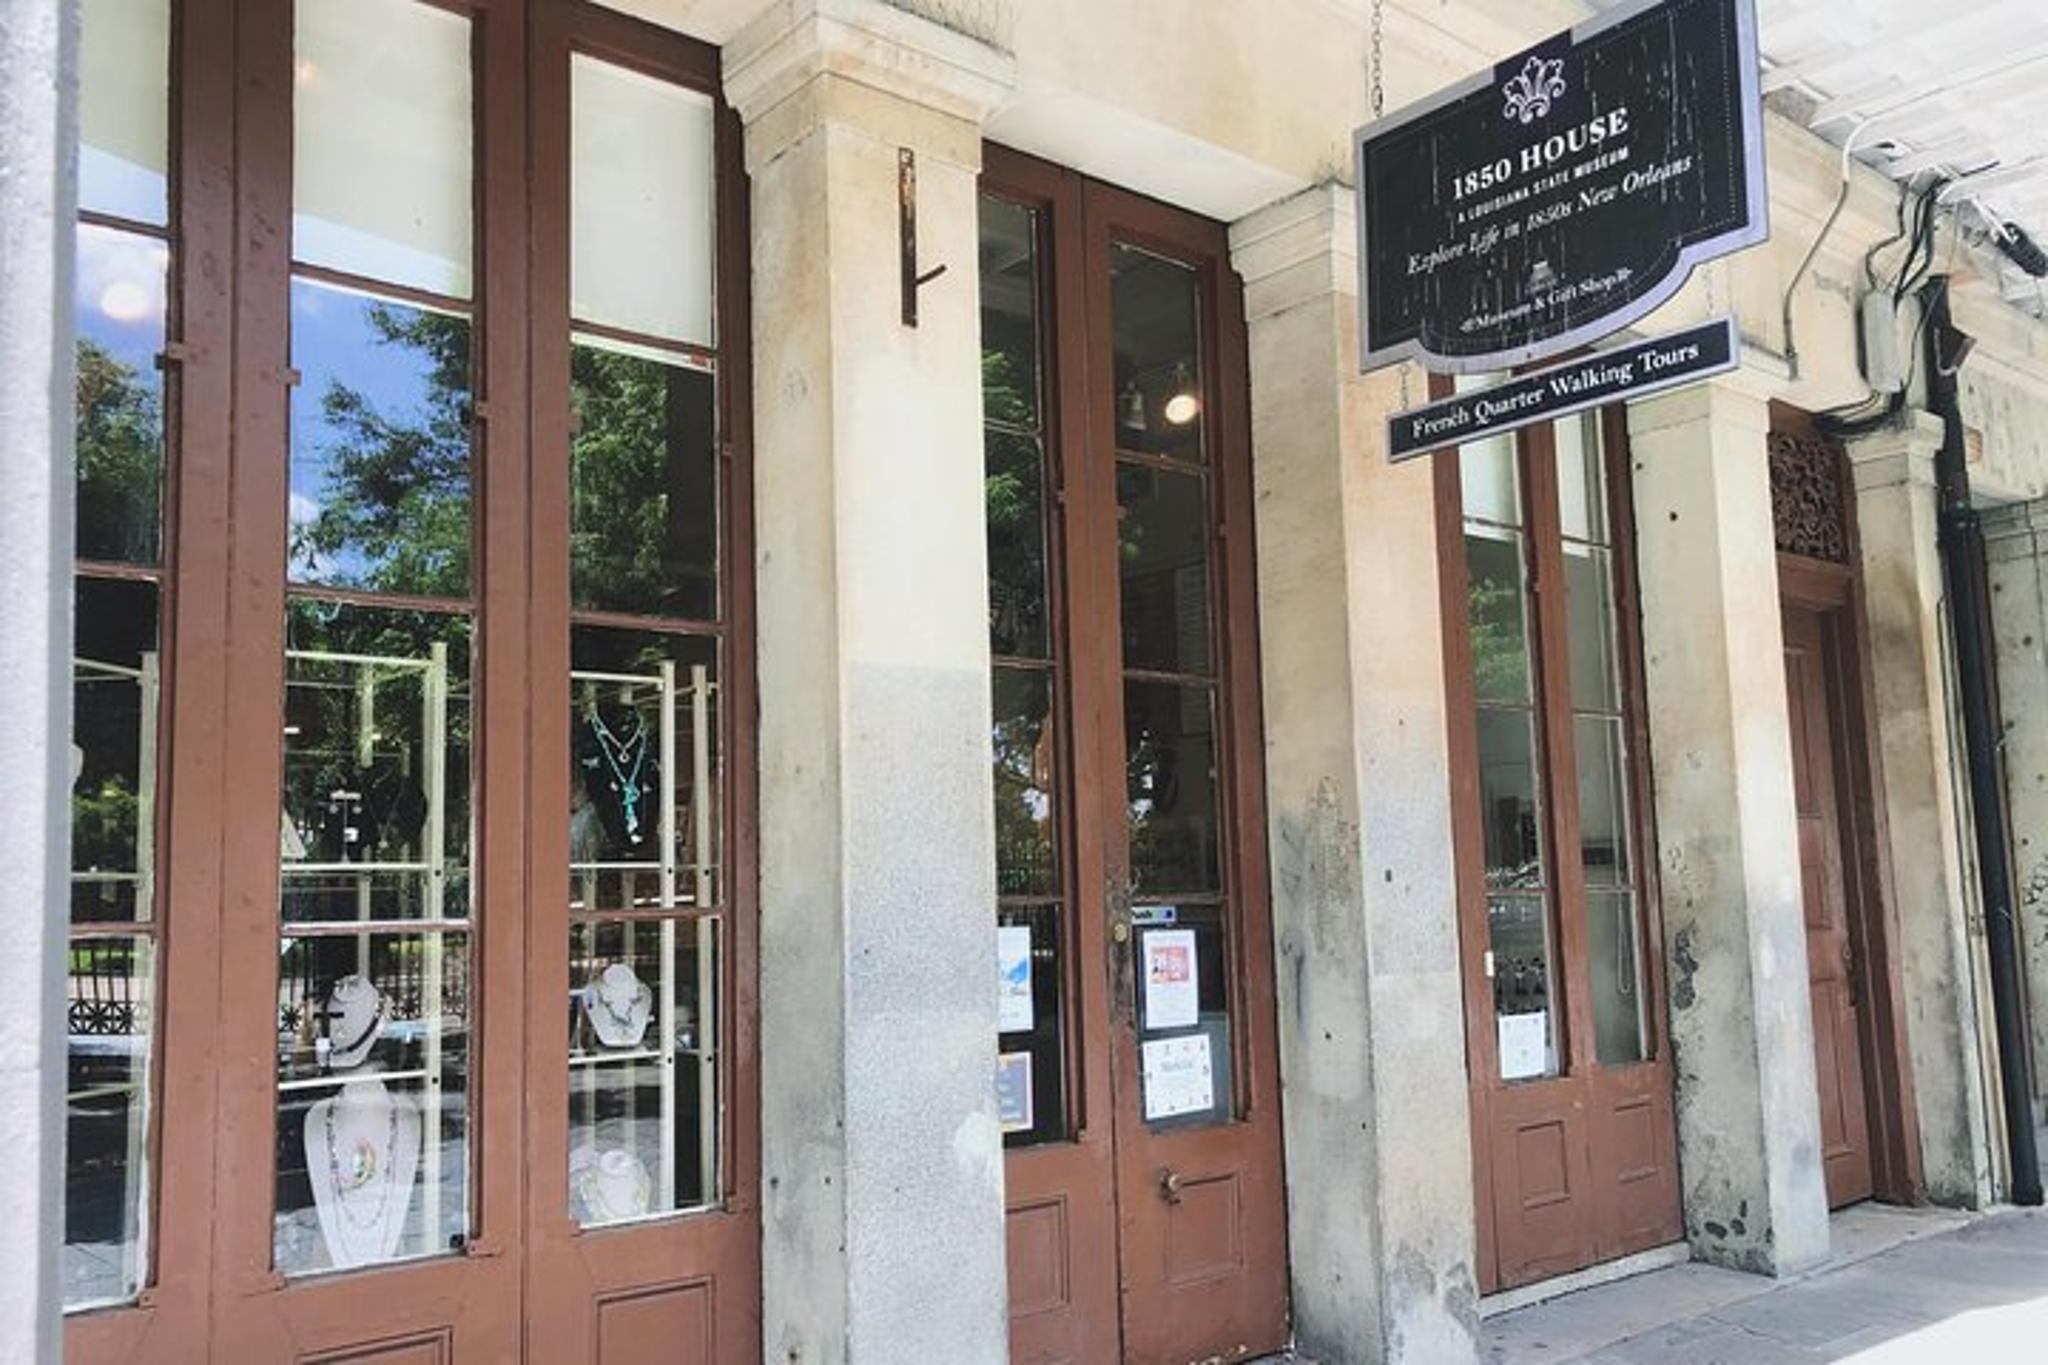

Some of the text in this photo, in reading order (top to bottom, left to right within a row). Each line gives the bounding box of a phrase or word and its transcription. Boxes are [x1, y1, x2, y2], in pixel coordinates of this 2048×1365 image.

[1453, 107, 1629, 200] 1850 HOUSE
[1532, 170, 1570, 195] STATE
[1573, 146, 1629, 179] MUSEUM
[1407, 155, 1692, 275] Explore Life in 1850s New Orleans
[1548, 284, 1577, 306] Gift
[1413, 343, 1699, 439] French Quarter Walking Tours
